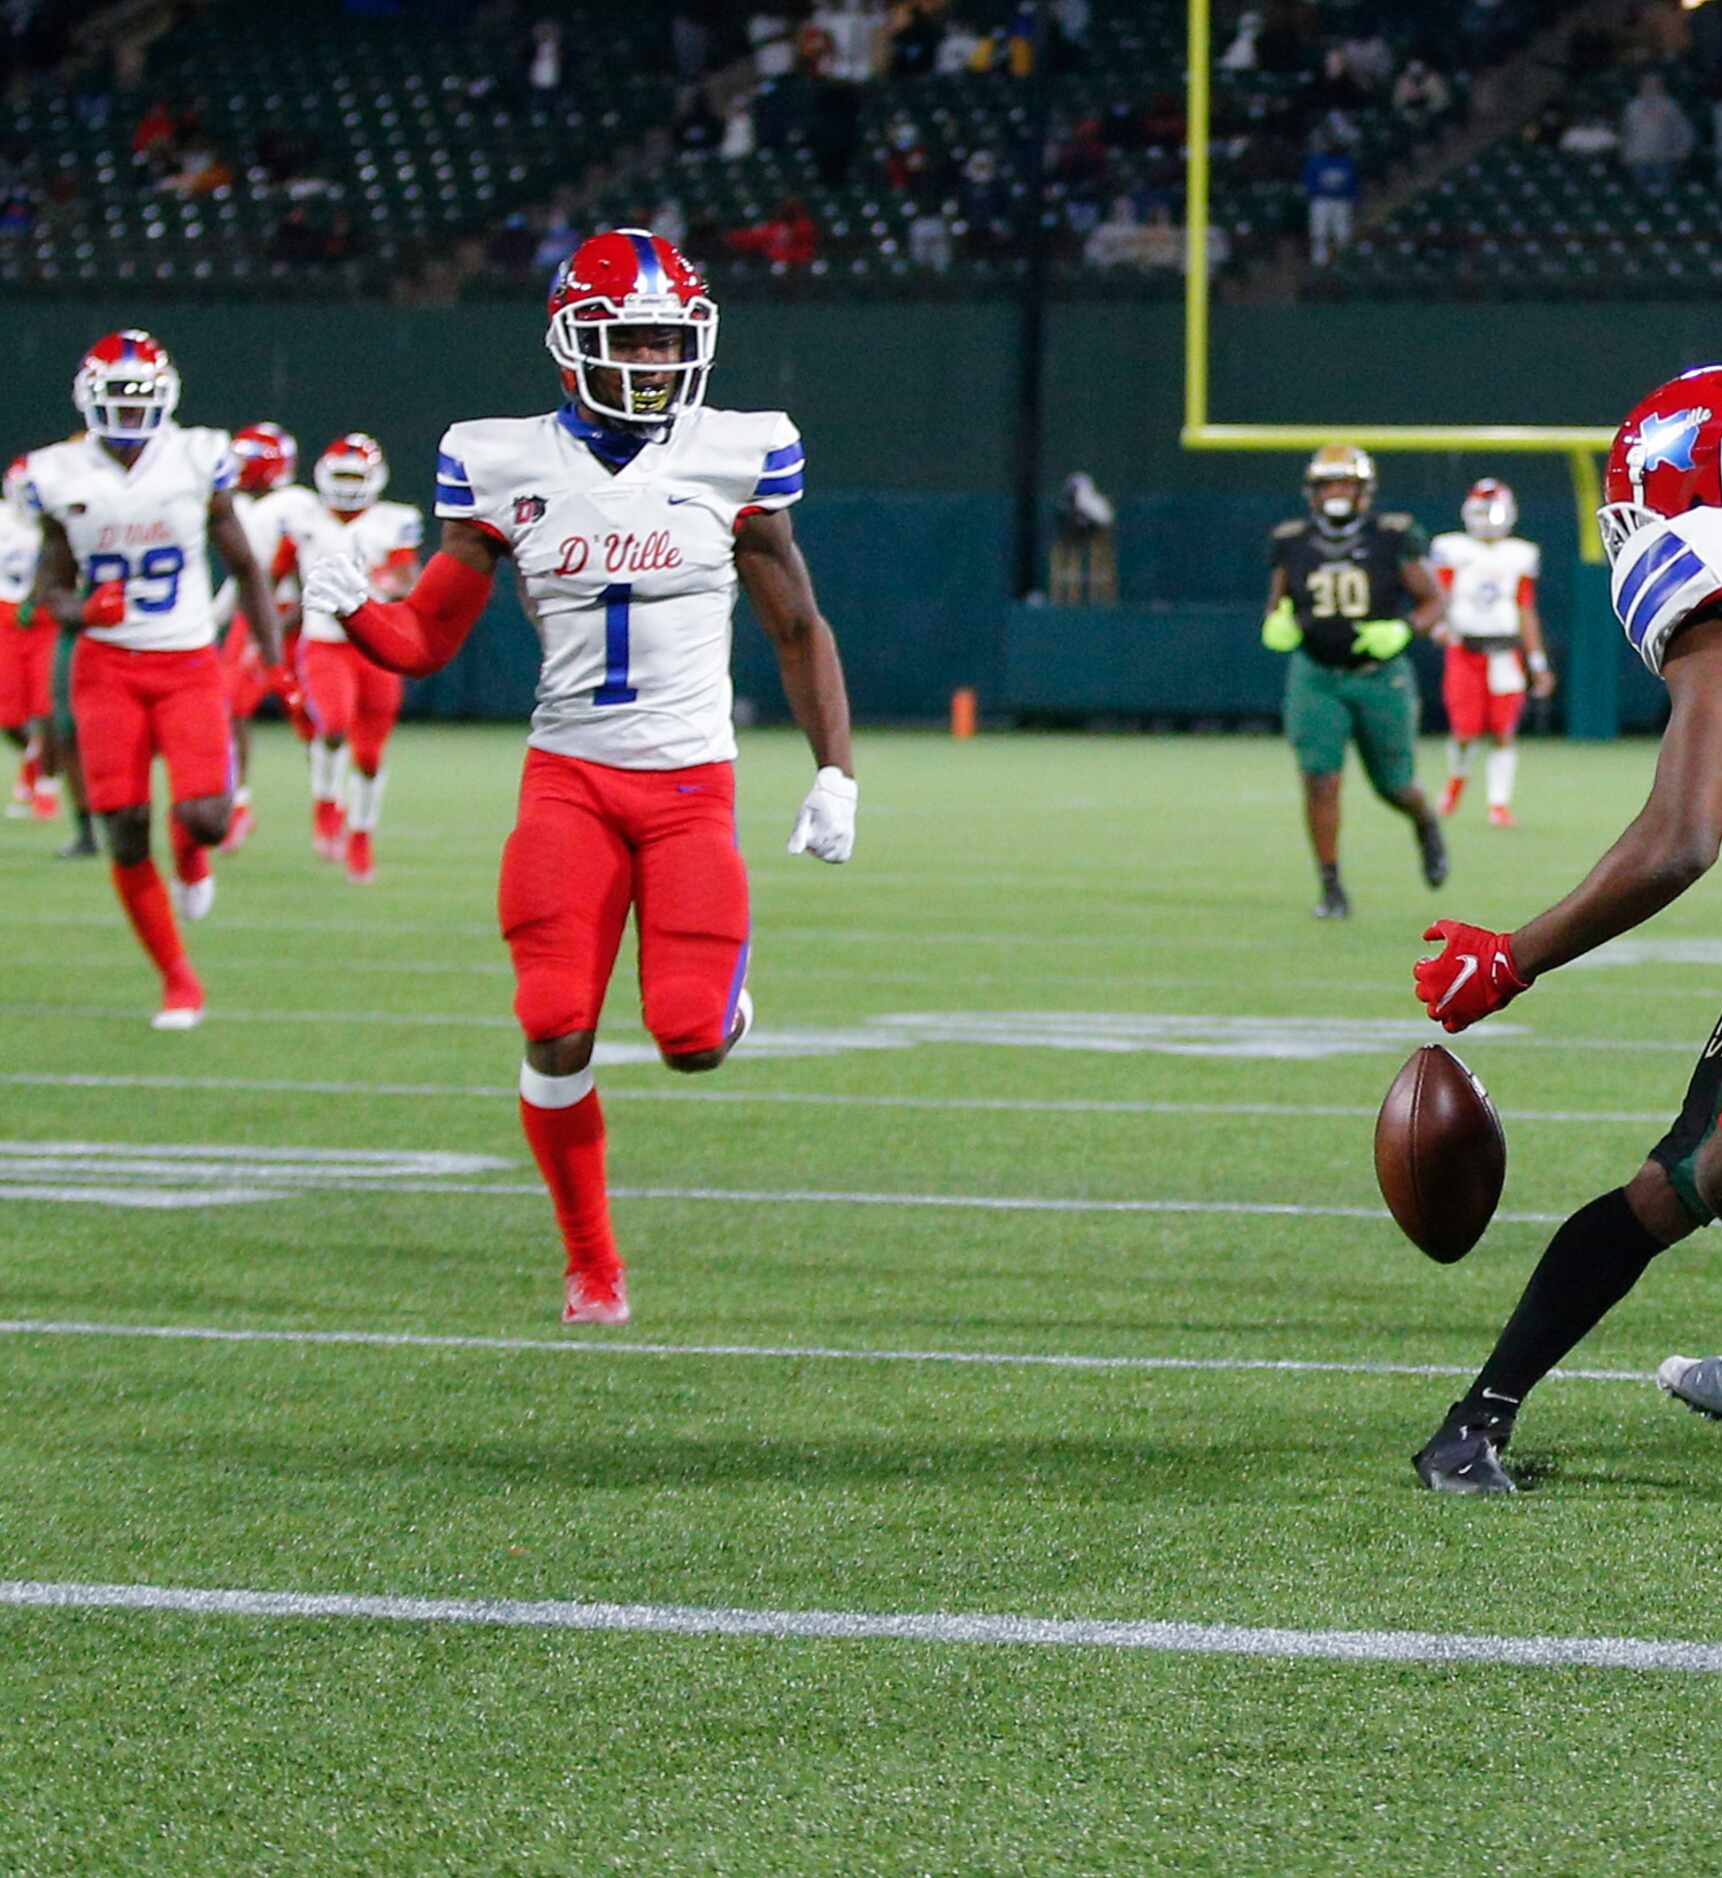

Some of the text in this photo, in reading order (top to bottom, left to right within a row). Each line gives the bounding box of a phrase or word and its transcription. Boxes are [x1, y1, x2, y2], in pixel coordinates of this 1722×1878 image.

[553, 529, 683, 577] D'Ville
[1305, 565, 1371, 619] 30
[592, 582, 639, 706] 1
